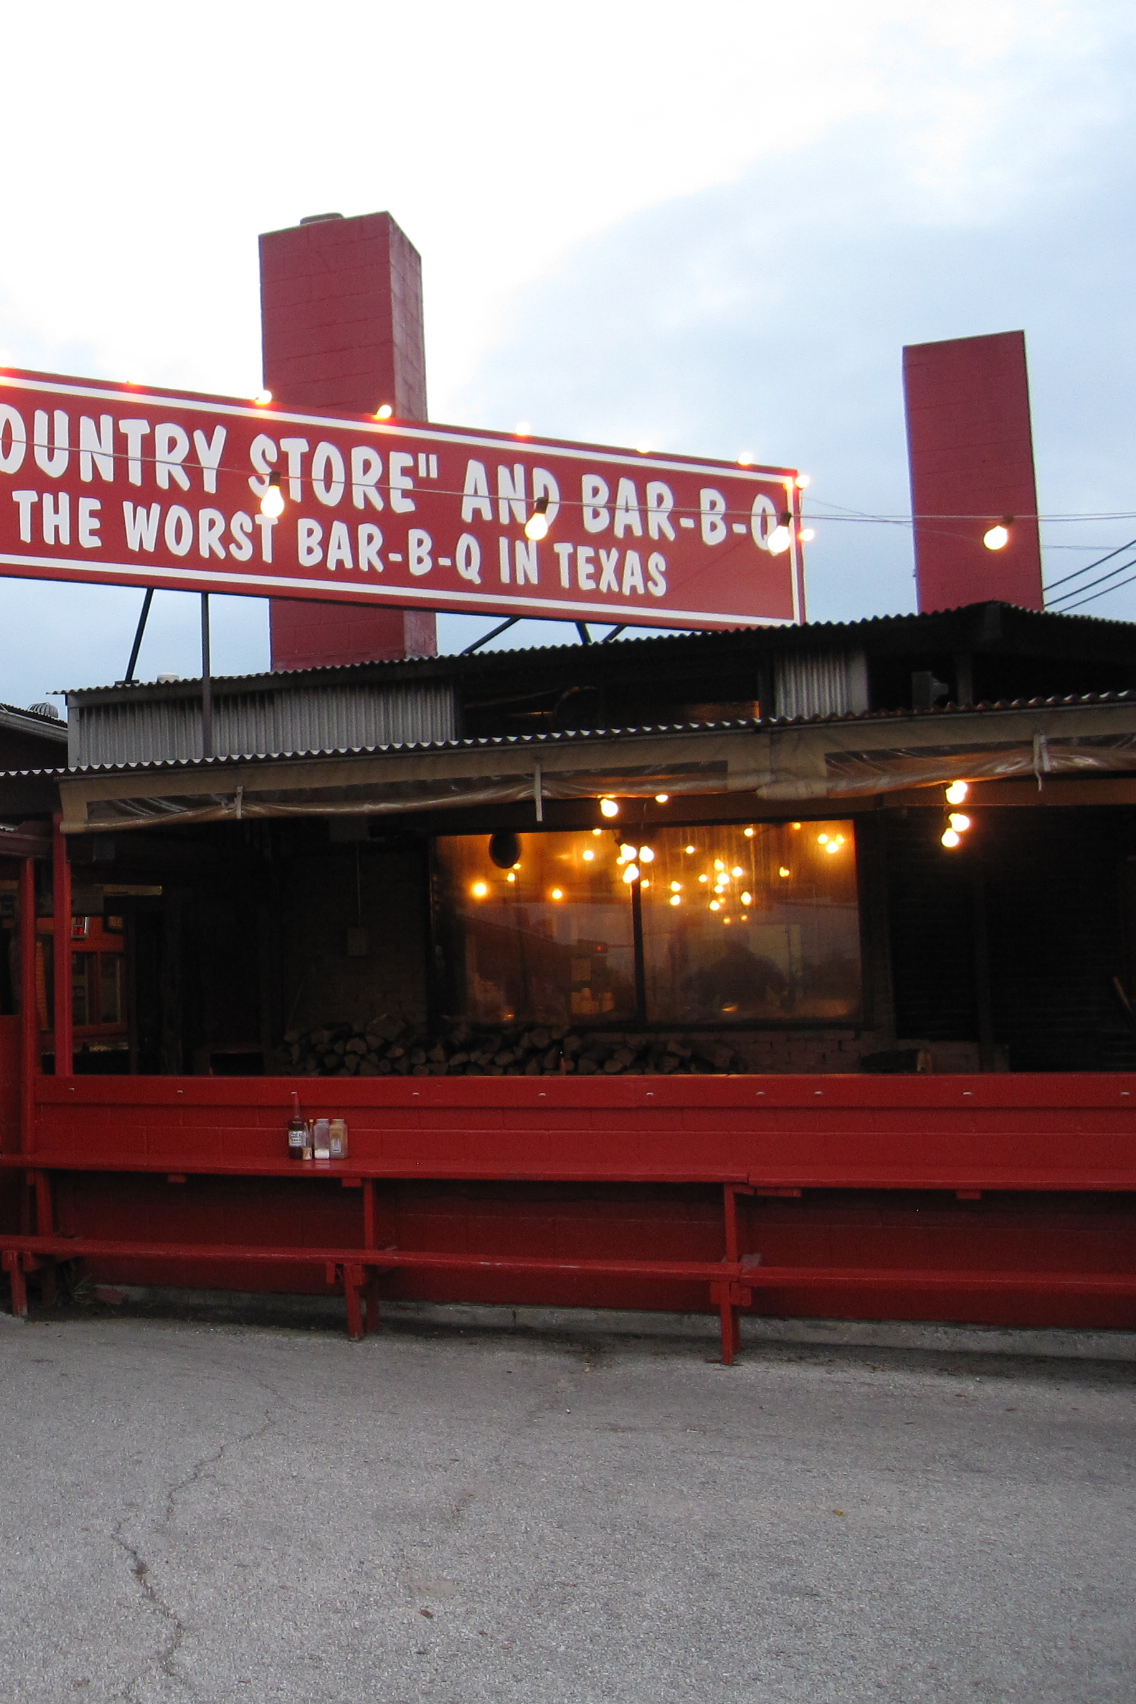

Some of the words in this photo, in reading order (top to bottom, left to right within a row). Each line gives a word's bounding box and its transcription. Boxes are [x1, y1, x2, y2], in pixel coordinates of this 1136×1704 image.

[11, 489, 103, 549] THE
[122, 500, 279, 563] WORST
[297, 517, 482, 585] BAR-B-Q
[499, 536, 539, 585] IN
[553, 541, 668, 598] TEXAS
[248, 433, 440, 514] STORE"
[461, 458, 561, 528] AND
[581, 472, 779, 556] BAR-B-Q
